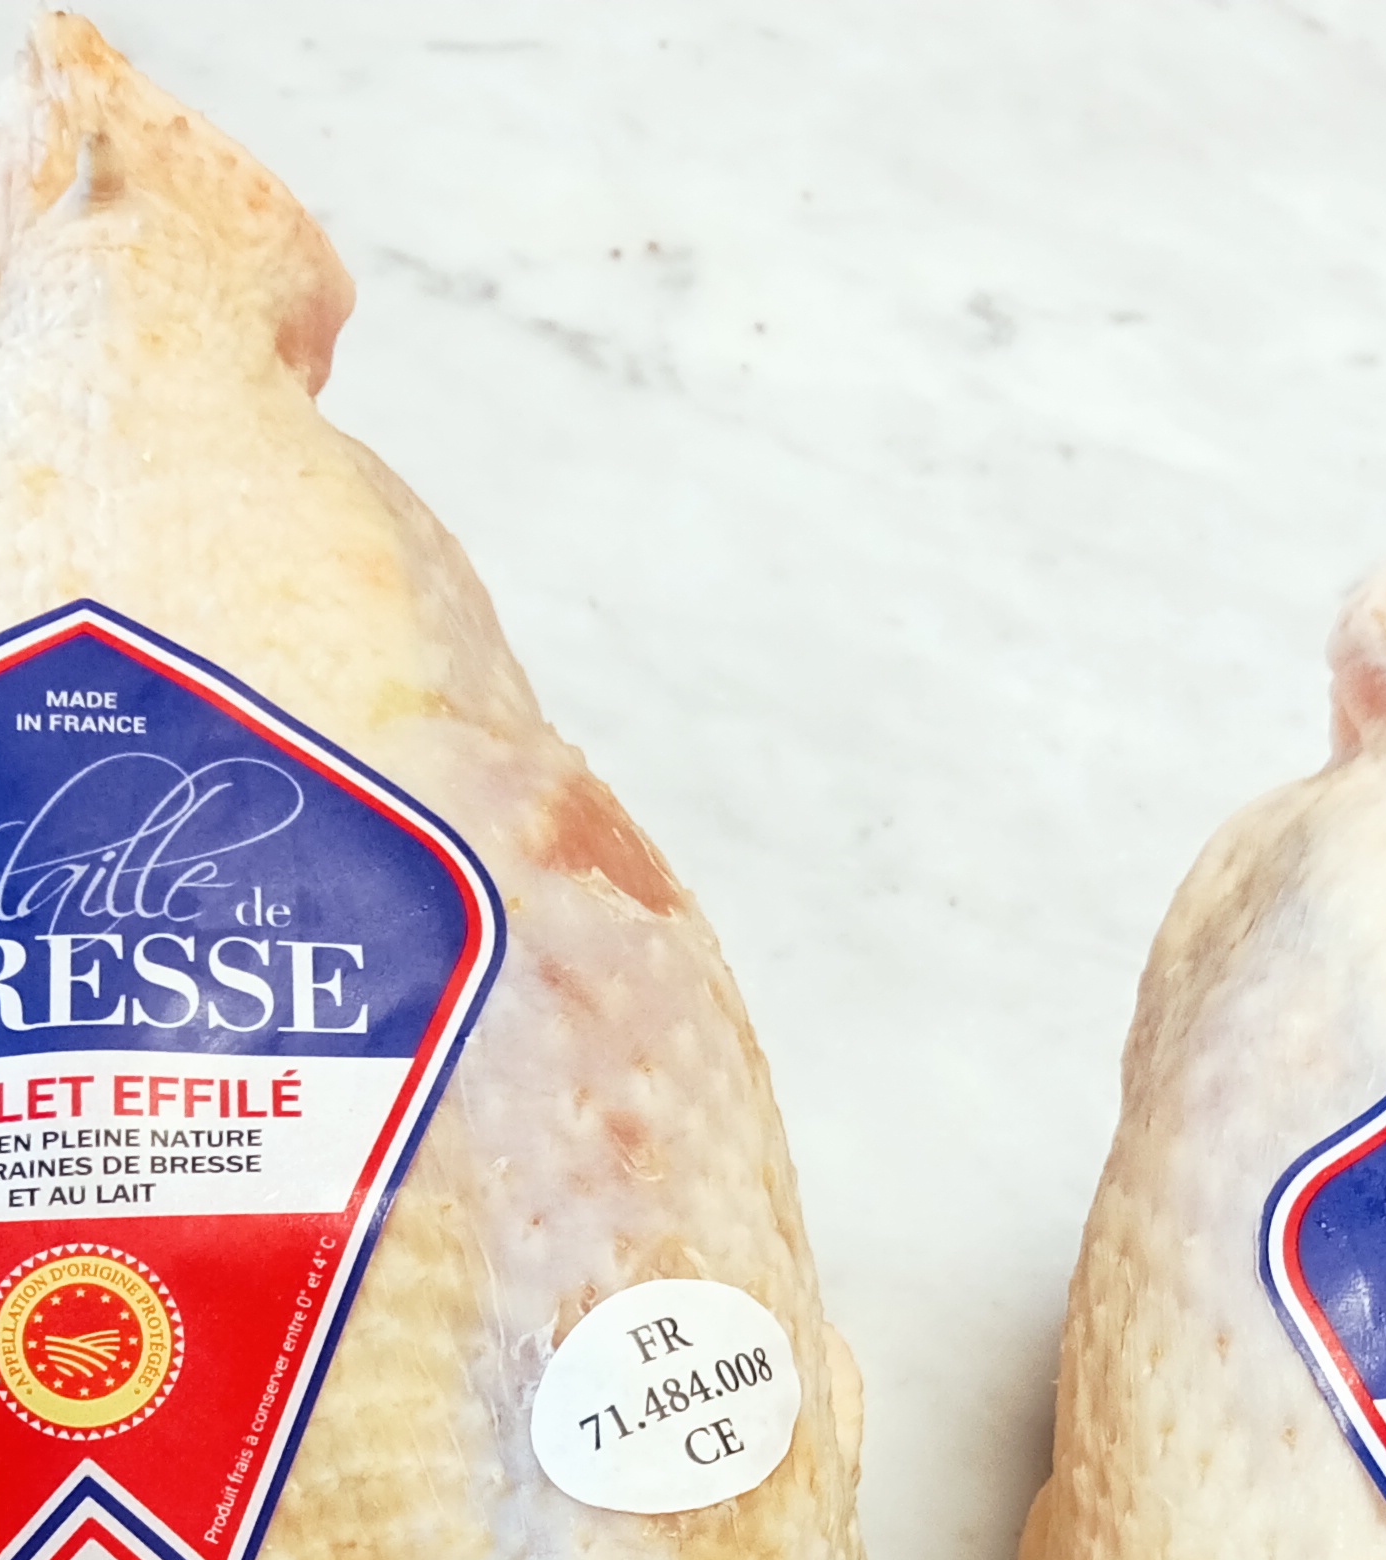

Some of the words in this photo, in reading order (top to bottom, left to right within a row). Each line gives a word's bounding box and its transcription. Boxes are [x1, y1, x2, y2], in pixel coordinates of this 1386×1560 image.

[46, 690, 117, 709] MADE
[16, 713, 42, 732] IN
[49, 714, 147, 734] FRANCE
[235, 886, 292, 930] de
[113, 1069, 303, 1118] EFFILÉ
[42, 1129, 140, 1150] PLEINE
[150, 1129, 263, 1148] NATURE
[102, 1155, 141, 1176] DE
[149, 1154, 263, 1175] BRESSE
[8, 1187, 42, 1208] ET
[47, 1186, 88, 1206] AU
[96, 1183, 156, 1204] LAIT
[1, 1274, 48, 1388] APPELLATION
[49, 1263, 141, 1297] D'ORIGINE
[136, 1293, 168, 1388] PROTÉGÉE
[626, 1316, 694, 1364] FR
[203, 1485, 240, 1545] Produit
[226, 1448, 254, 1484] frais
[251, 1353, 290, 1432] conserver
[282, 1310, 308, 1352] entre
[307, 1271, 323, 1288] et
[319, 1235, 336, 1249] C
[578, 1346, 773, 1451] 71.484.008
[684, 1417, 745, 1465] CE
